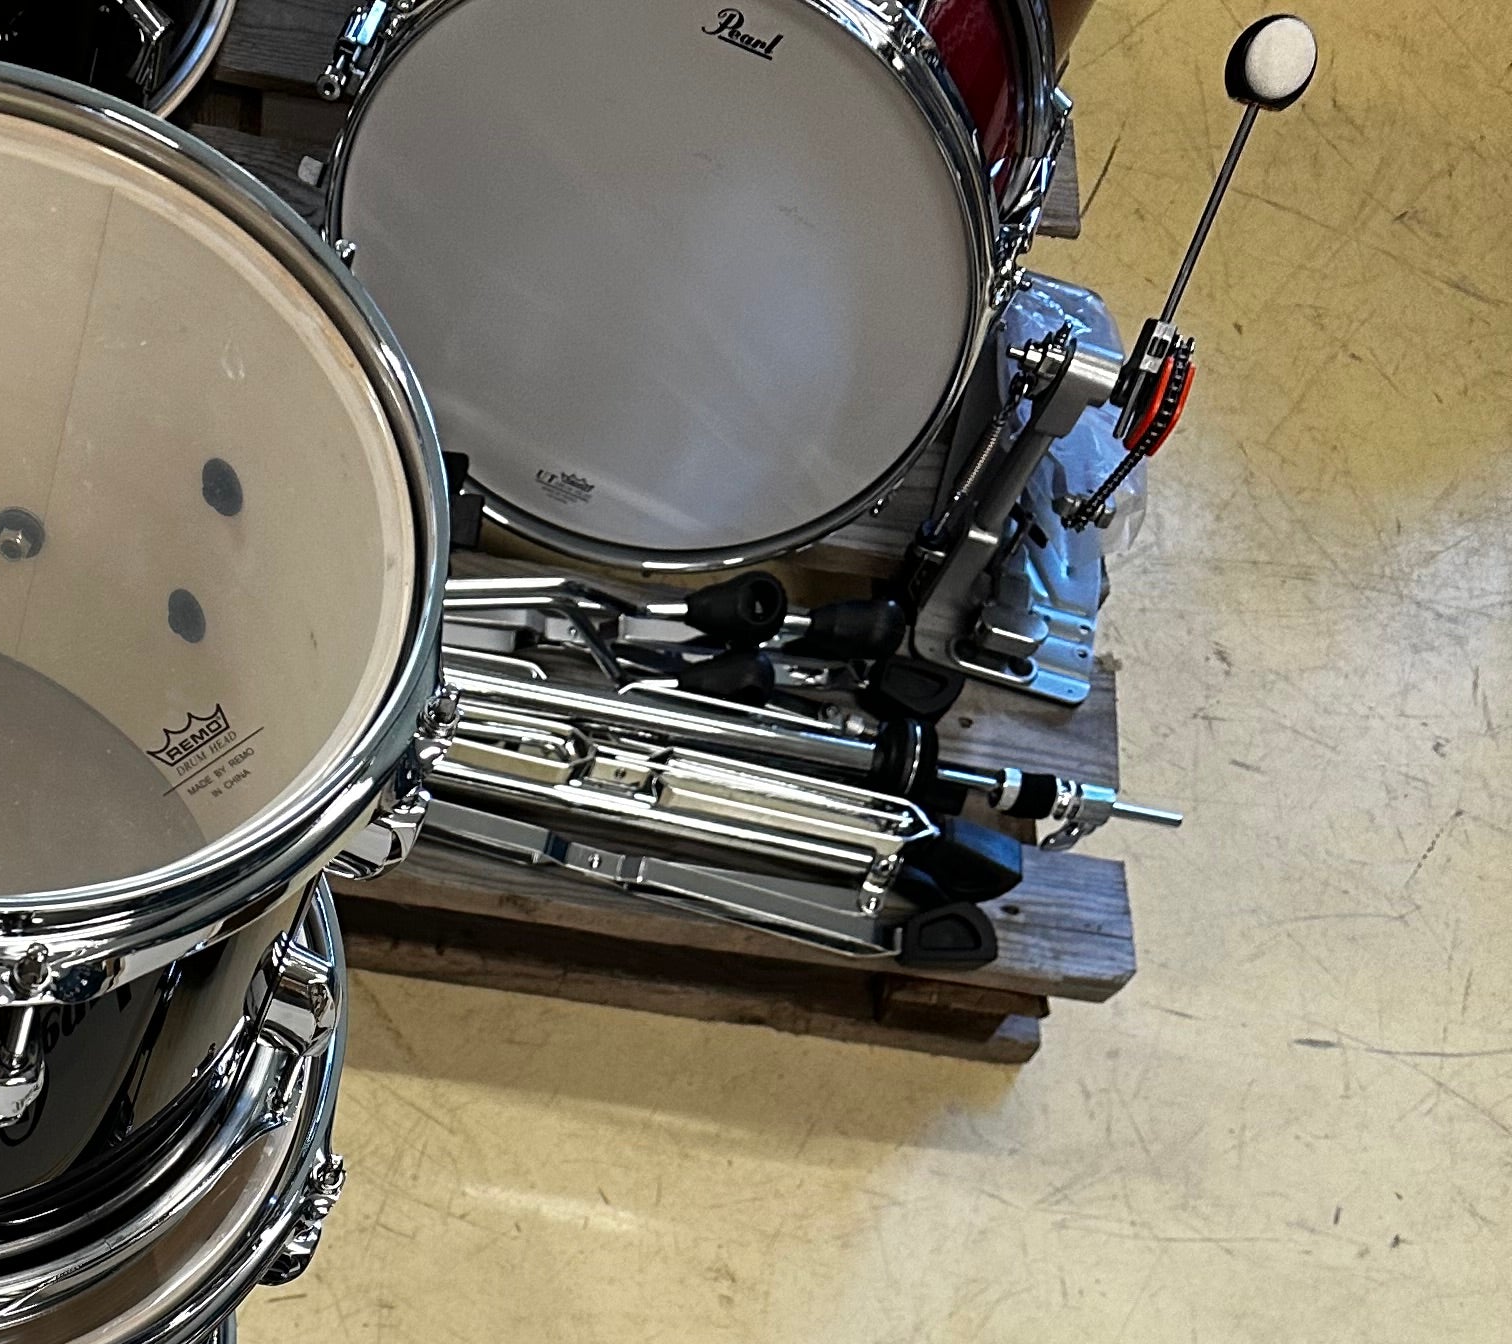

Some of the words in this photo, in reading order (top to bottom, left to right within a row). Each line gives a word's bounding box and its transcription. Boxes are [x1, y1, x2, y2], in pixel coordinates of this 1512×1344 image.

[701, 7, 784, 60] Pearl
[165, 719, 223, 761] REMO
[176, 750, 207, 777] DRUM
[209, 730, 237, 754] HEAD
[187, 776, 213, 796] MADE
[213, 765, 227, 778] BY
[228, 747, 255, 768] REMO
[211, 787, 223, 798] IN
[223, 769, 251, 790] CHINA
